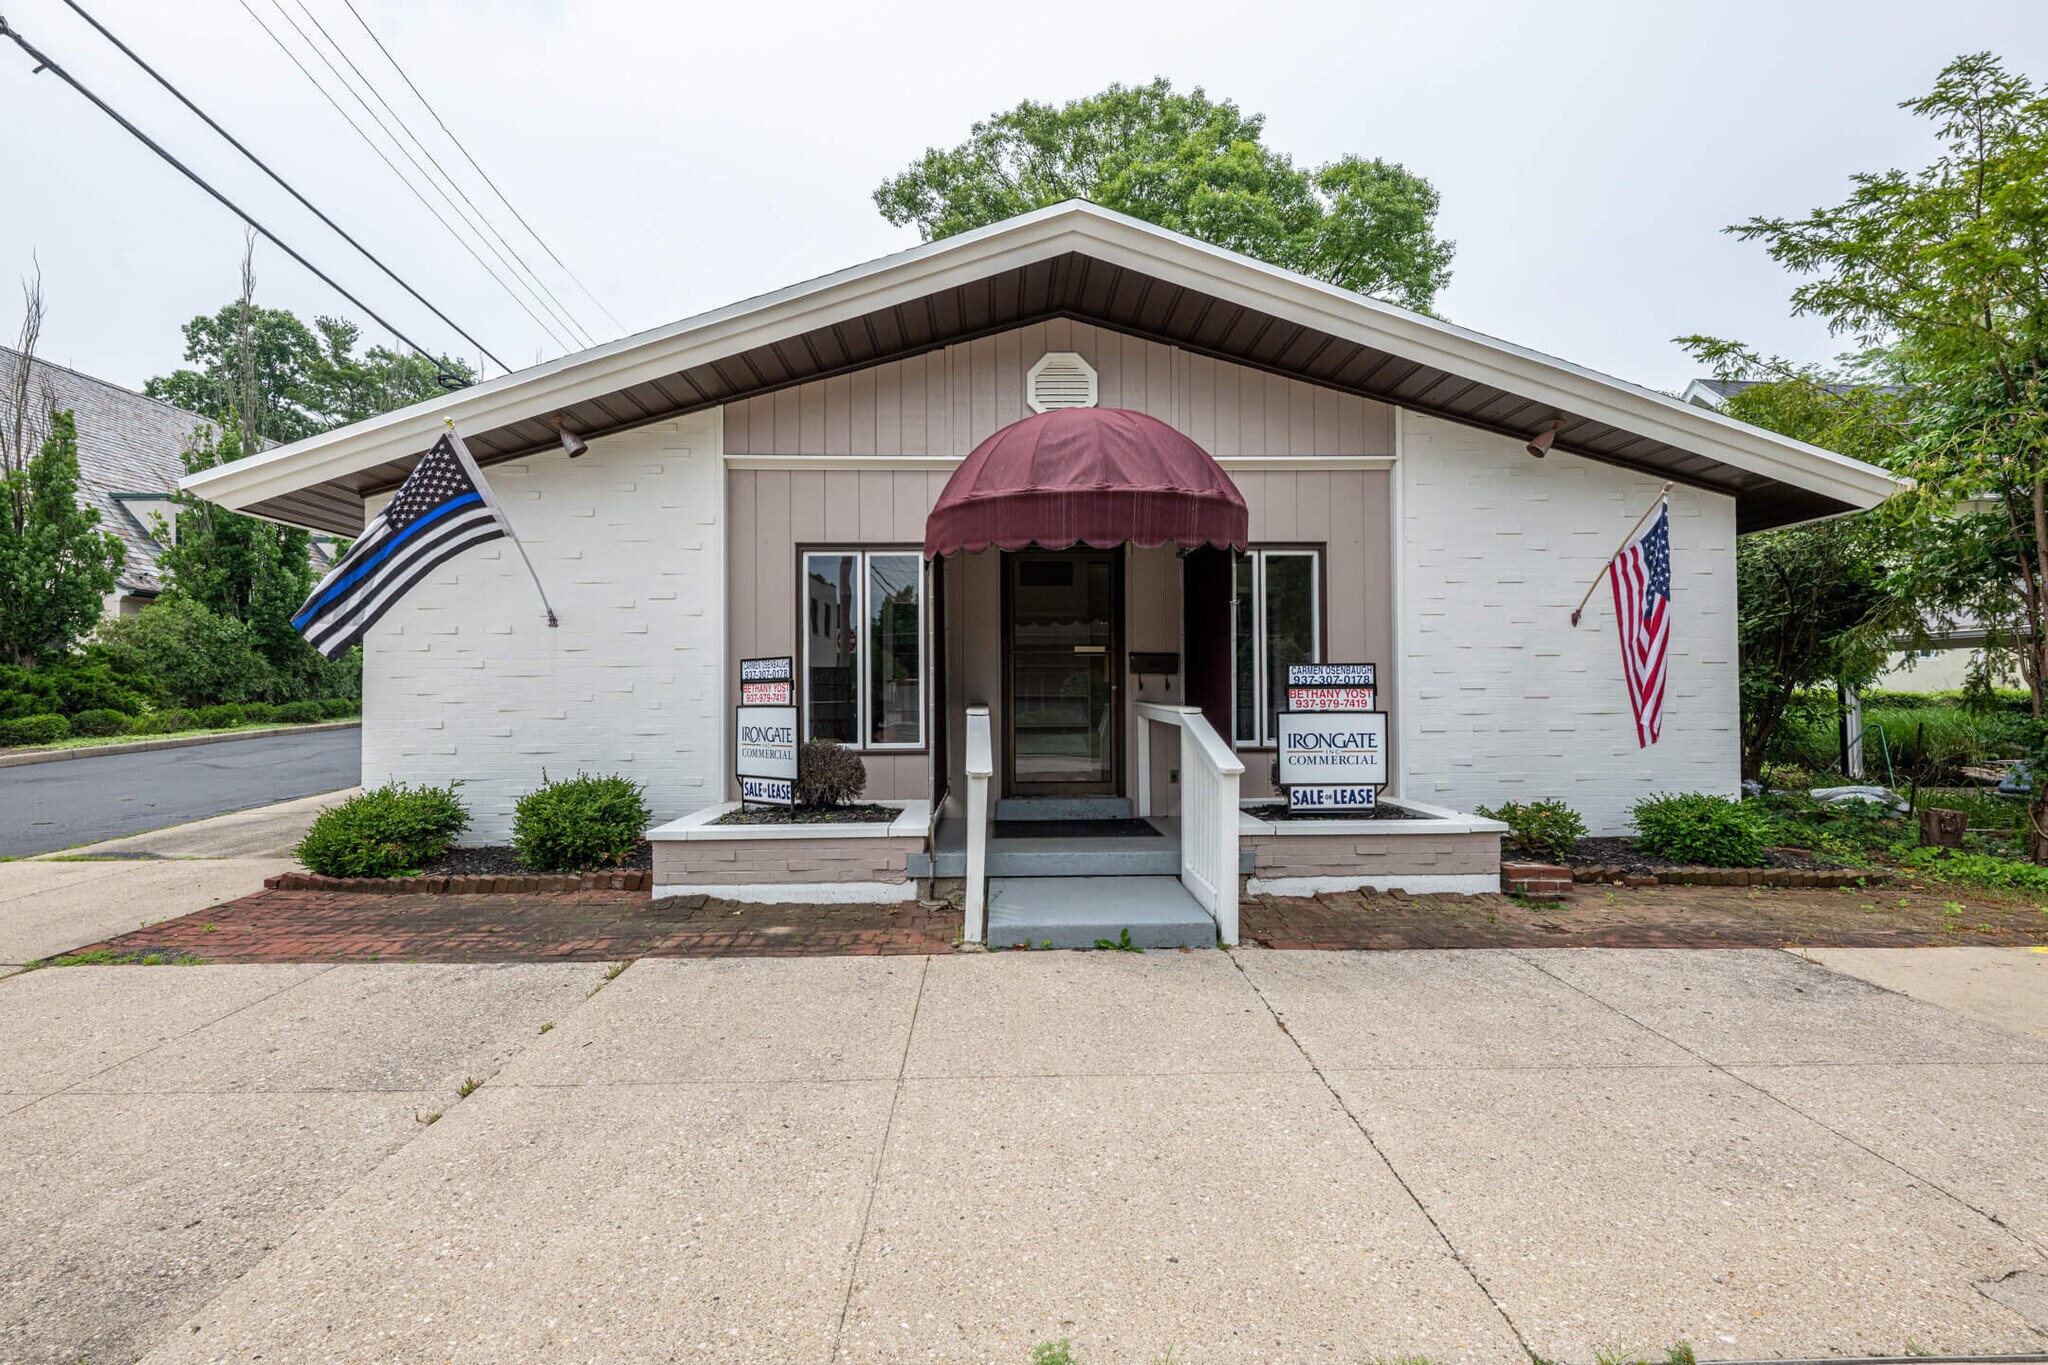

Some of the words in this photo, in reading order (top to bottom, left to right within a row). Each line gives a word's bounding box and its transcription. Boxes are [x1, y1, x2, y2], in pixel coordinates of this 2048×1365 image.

[744, 669, 788, 679] 937-307-0178
[1291, 666, 1323, 675] CARMEN
[1325, 665, 1372, 675] OSENBAUGH
[1293, 675, 1370, 685] 937-307-0178
[743, 683, 771, 693] BETHANY
[774, 682, 789, 692] YOST
[746, 693, 786, 703] 937-979-7419
[1289, 689, 1341, 698] BETHANY
[1344, 689, 1372, 698] YOST
[1295, 699, 1367, 708] 937-979-7419
[741, 727, 793, 743] IRONGATE
[1287, 733, 1378, 750] IRONGATE
[742, 747, 793, 760] COMMERCIAL
[1288, 755, 1378, 765] COMMERCIAL
[744, 781, 763, 798] SALE
[767, 783, 791, 800] LEASE
[1292, 789, 1324, 805] SALE
[1333, 788, 1373, 805] LEASE
